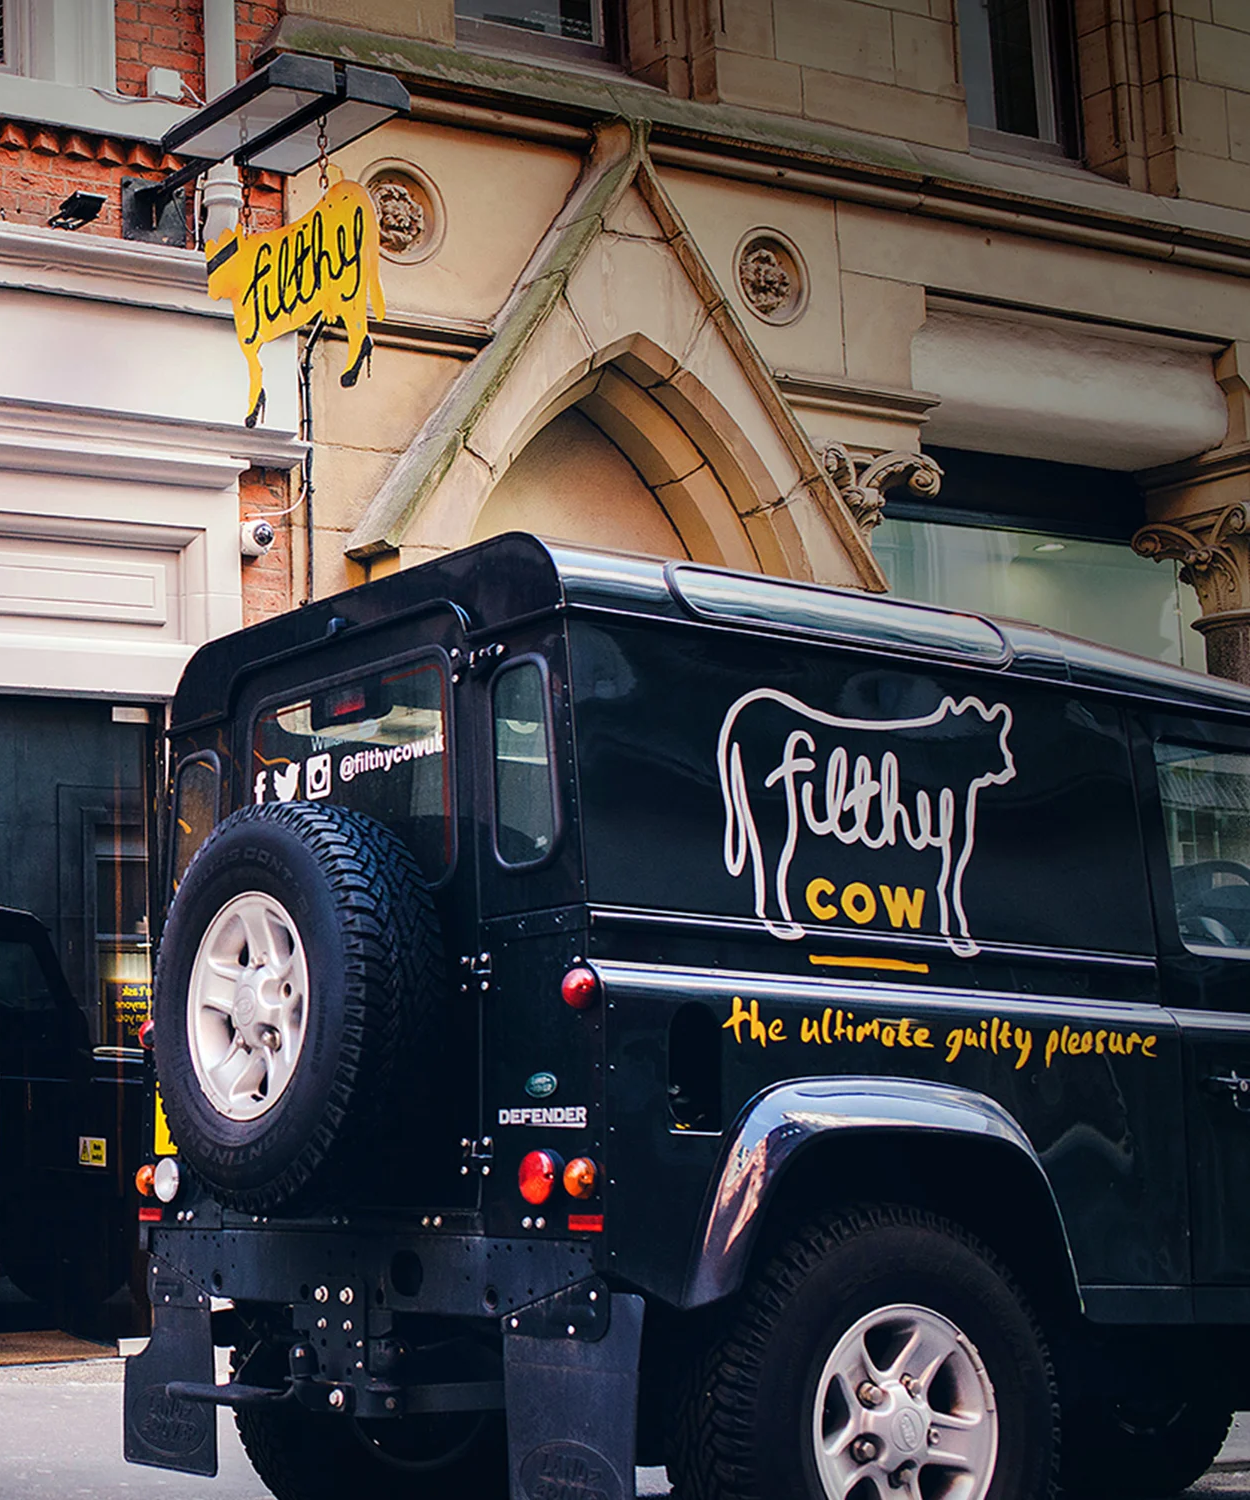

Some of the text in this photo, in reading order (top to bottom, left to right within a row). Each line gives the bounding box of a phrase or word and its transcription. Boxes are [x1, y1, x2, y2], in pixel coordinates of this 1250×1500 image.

[242, 206, 364, 345] filthy
[338, 733, 445, 782] @filthycowuk
[765, 730, 954, 852] filthy
[806, 878, 925, 929] COW
[722, 996, 1158, 1069] the ultimate guilty pleasure
[498, 1106, 587, 1125] DEFENDER
